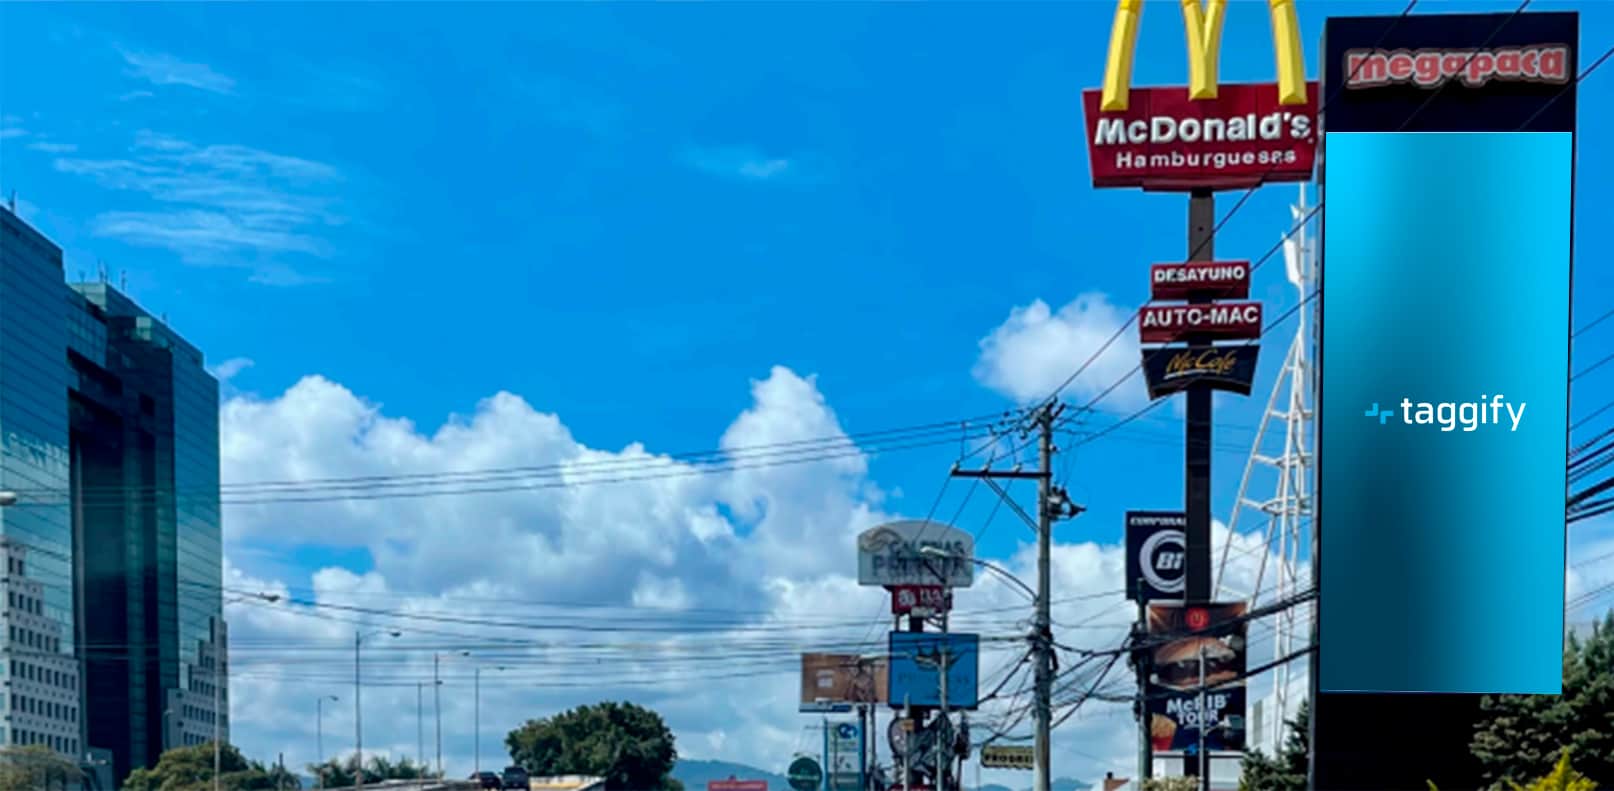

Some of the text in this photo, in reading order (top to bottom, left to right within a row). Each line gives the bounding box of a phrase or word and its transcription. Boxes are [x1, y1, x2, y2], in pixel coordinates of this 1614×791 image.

[1347, 48, 1567, 84] megapaca
[1094, 112, 1312, 146] McDonald's
[1115, 149, 1298, 170] Hamburguesas
[1154, 265, 1246, 283] DESAYUNO
[1142, 305, 1259, 328] AUTO-MAC
[1400, 394, 1527, 432] taggify
